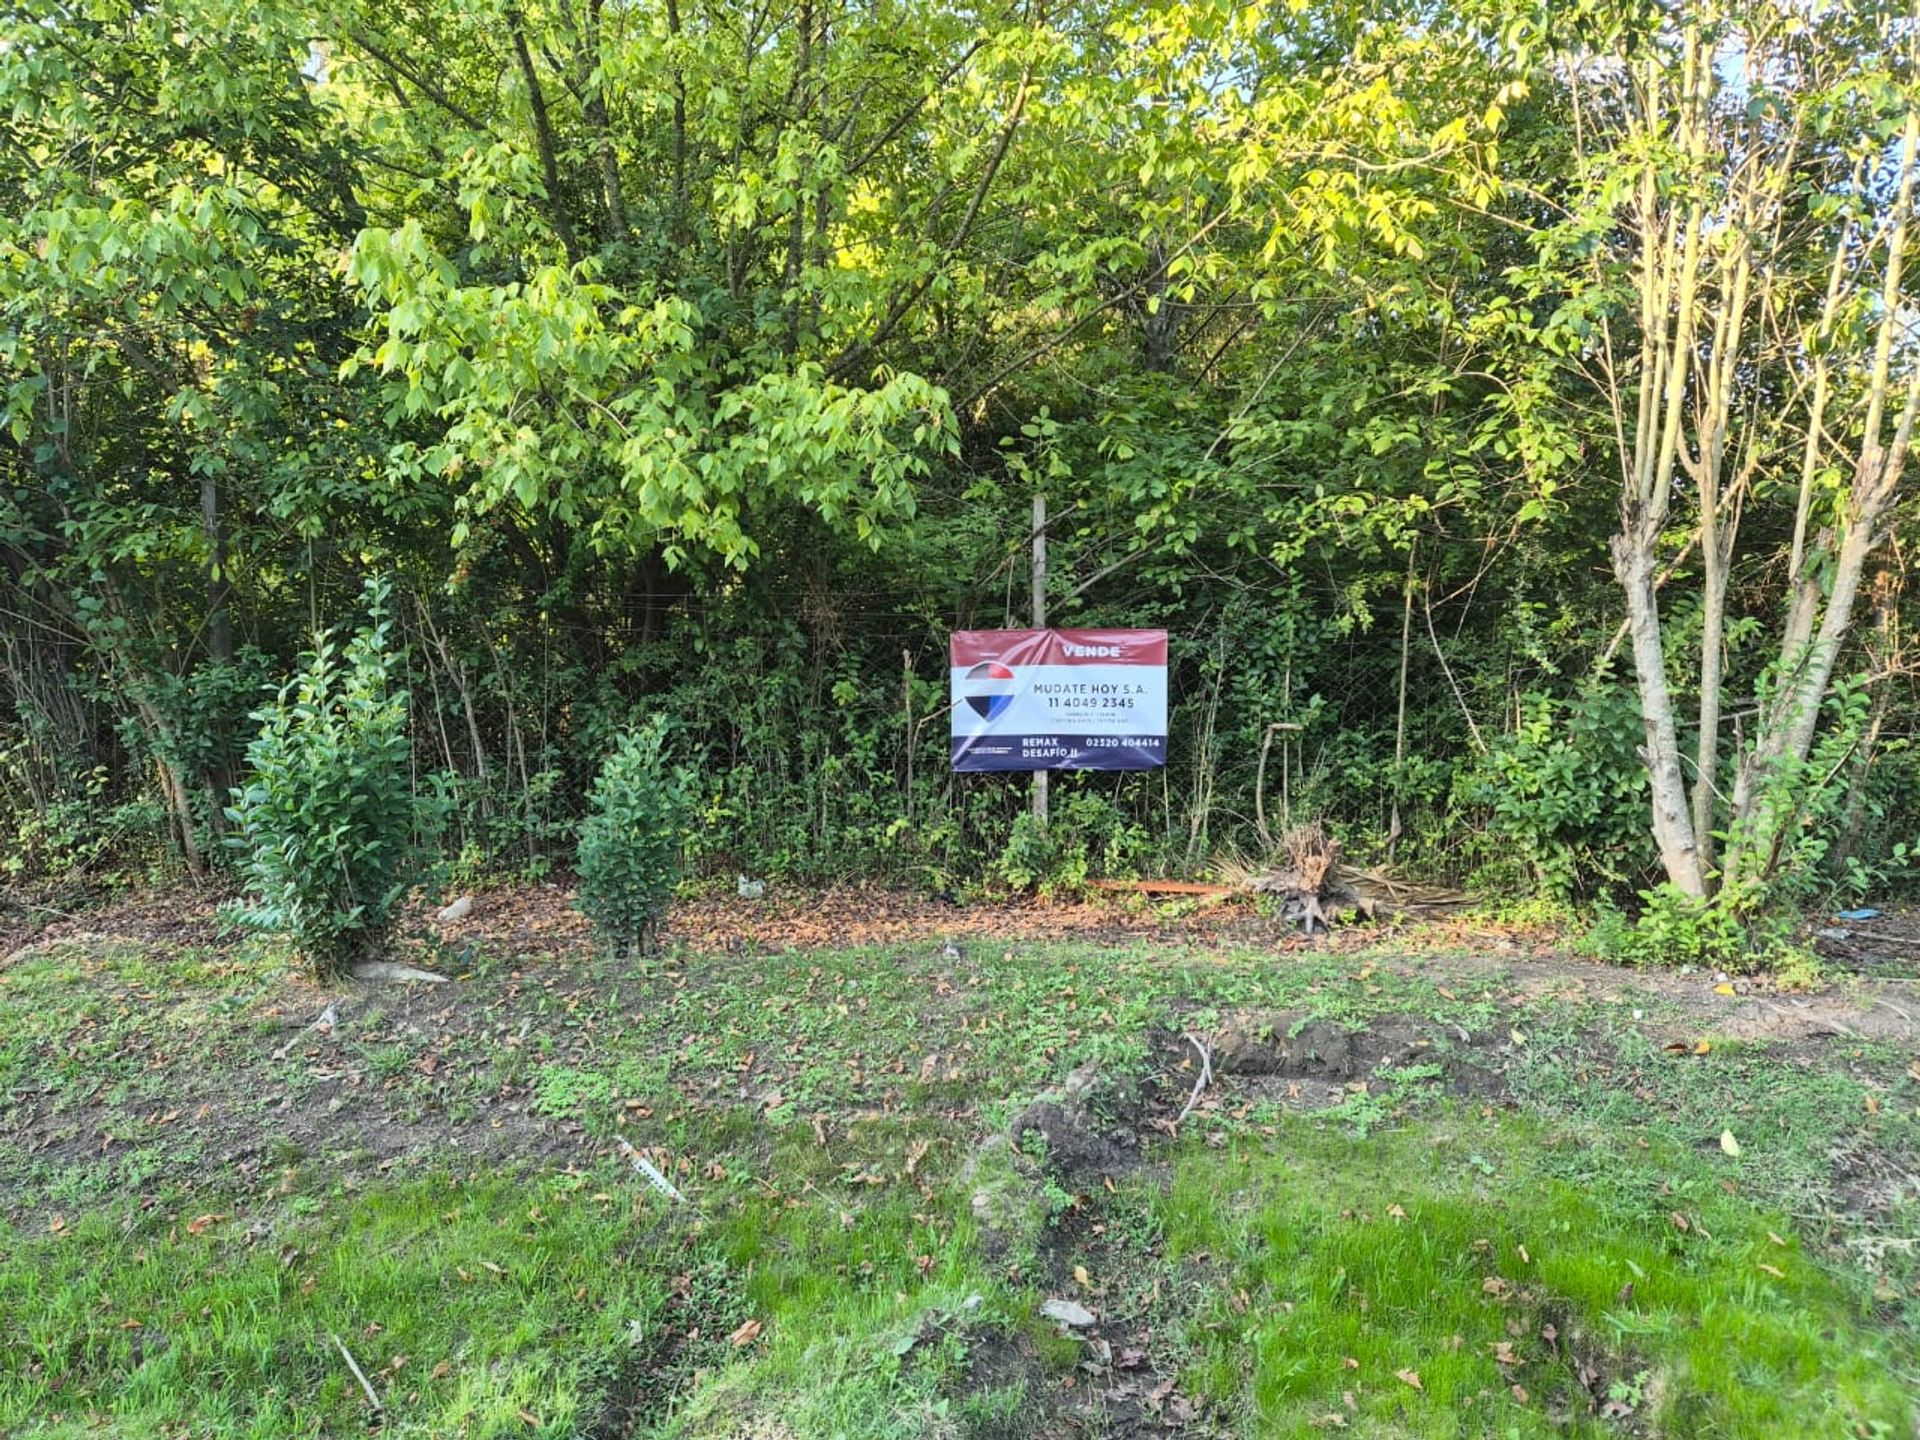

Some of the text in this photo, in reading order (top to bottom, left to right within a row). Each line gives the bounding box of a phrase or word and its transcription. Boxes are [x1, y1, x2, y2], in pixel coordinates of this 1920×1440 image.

[1062, 645, 1121, 657] VENDE
[1033, 683, 1148, 694] MUDATE HOY S.A.
[1048, 697, 1135, 708] 11 4049 2345
[1022, 737, 1059, 747] REMAX
[1022, 747, 1068, 758] DESAFÍO
